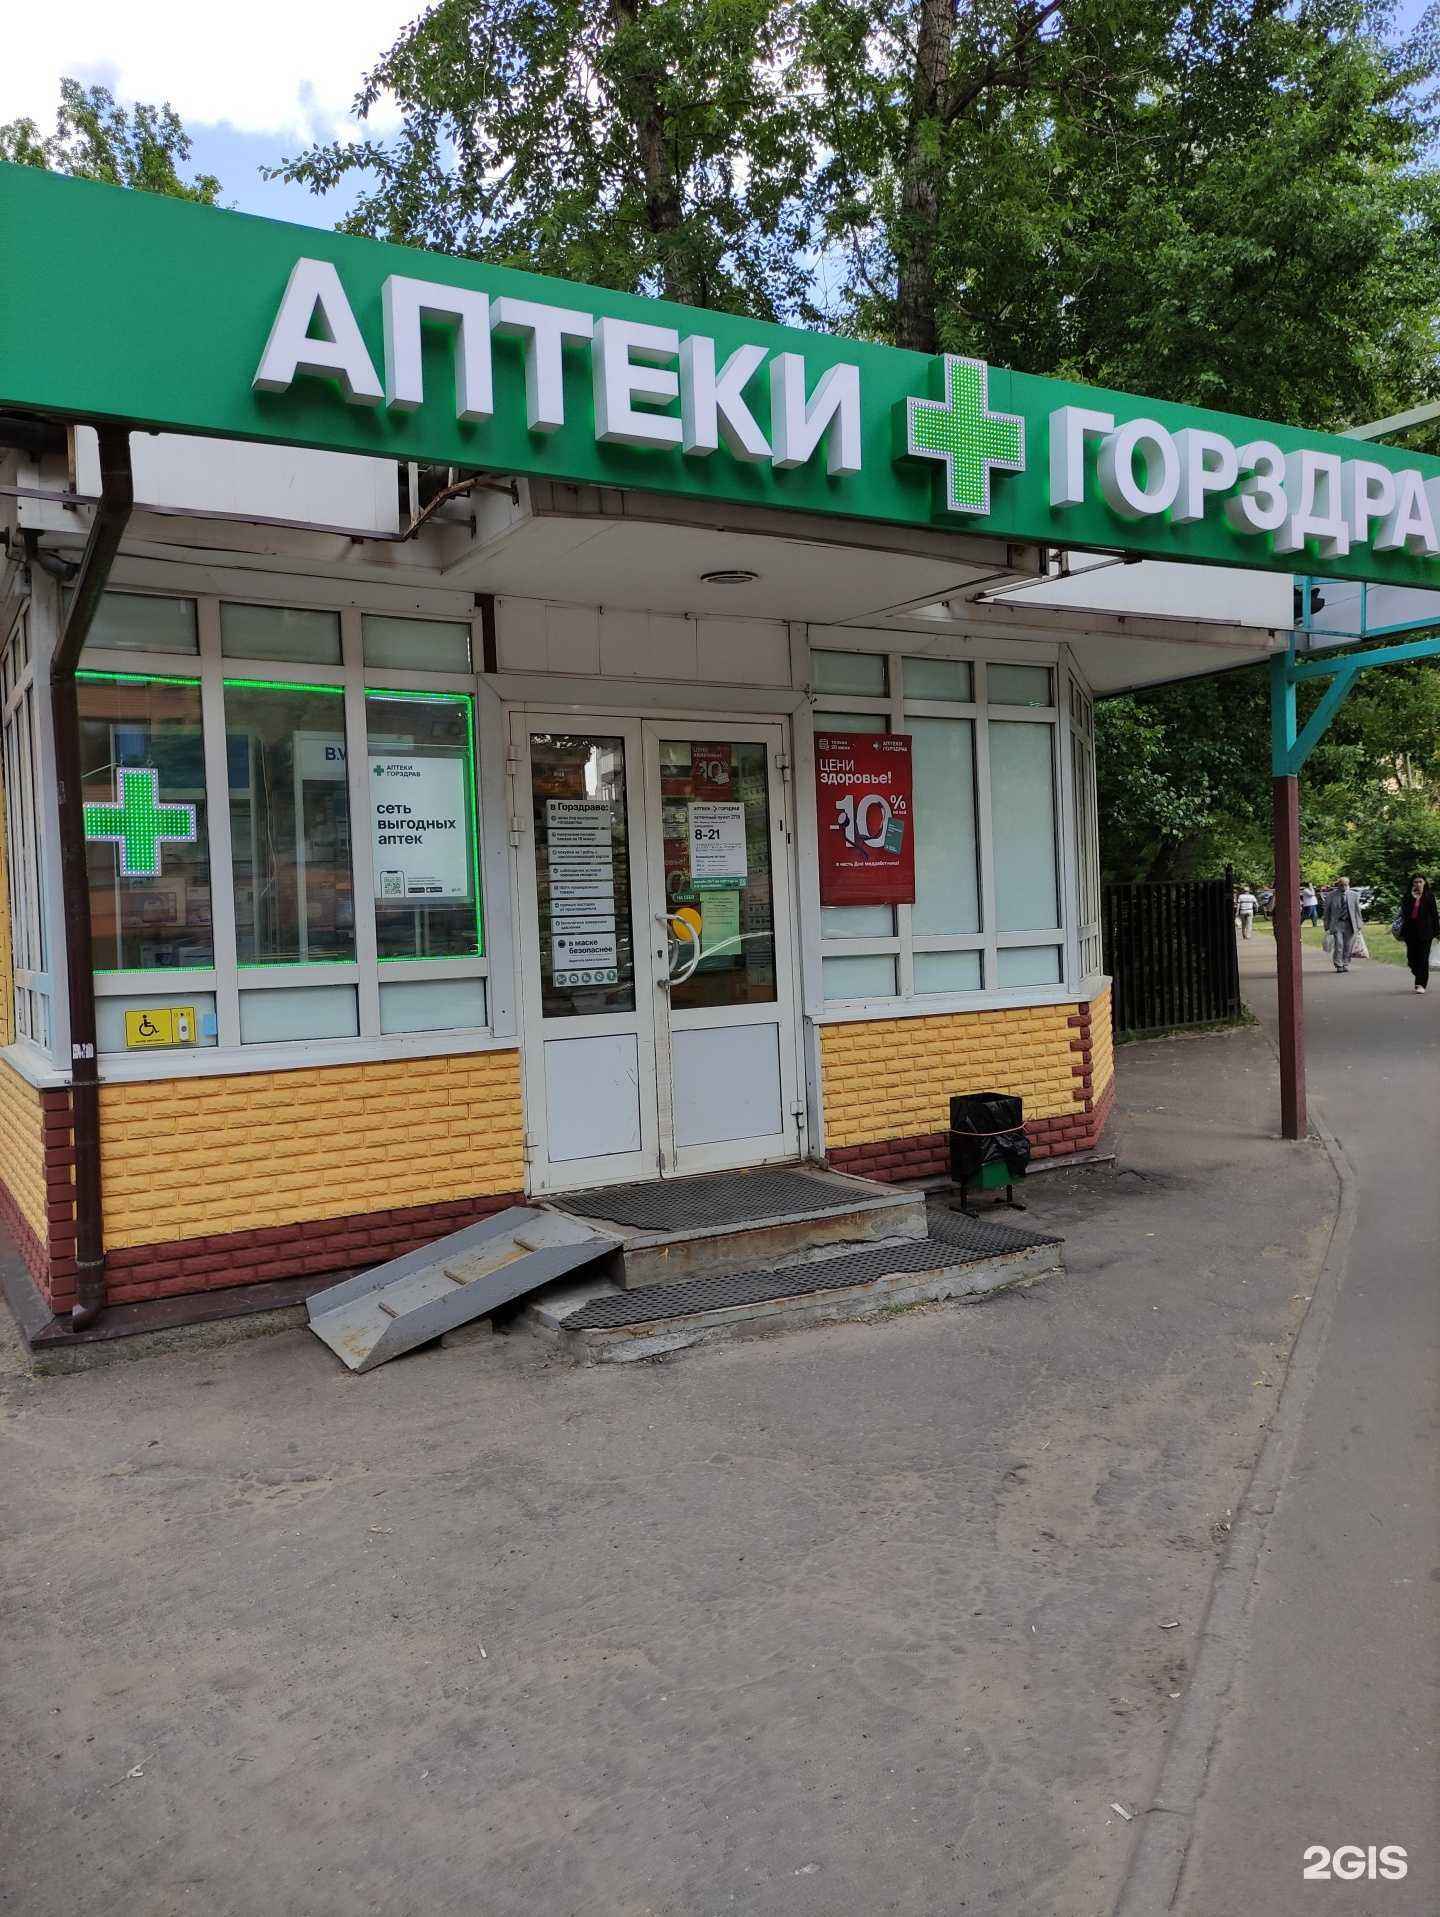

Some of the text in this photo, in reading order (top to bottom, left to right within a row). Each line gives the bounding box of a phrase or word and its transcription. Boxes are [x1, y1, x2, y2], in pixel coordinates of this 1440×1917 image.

[252, 257, 1440, 559] АПТЕКИ ГОРЗДРА
[820, 759, 855, 773] ЦЕНИ
[820, 771, 892, 786] здоровье!
[376, 804, 412, 814] сеть
[558, 802, 609, 812] Горздраве:
[377, 820, 456, 831] выгодных
[378, 835, 423, 845] аптек
[694, 829, 720, 840] 8-21
[569, 947, 613, 955] безопаснее
